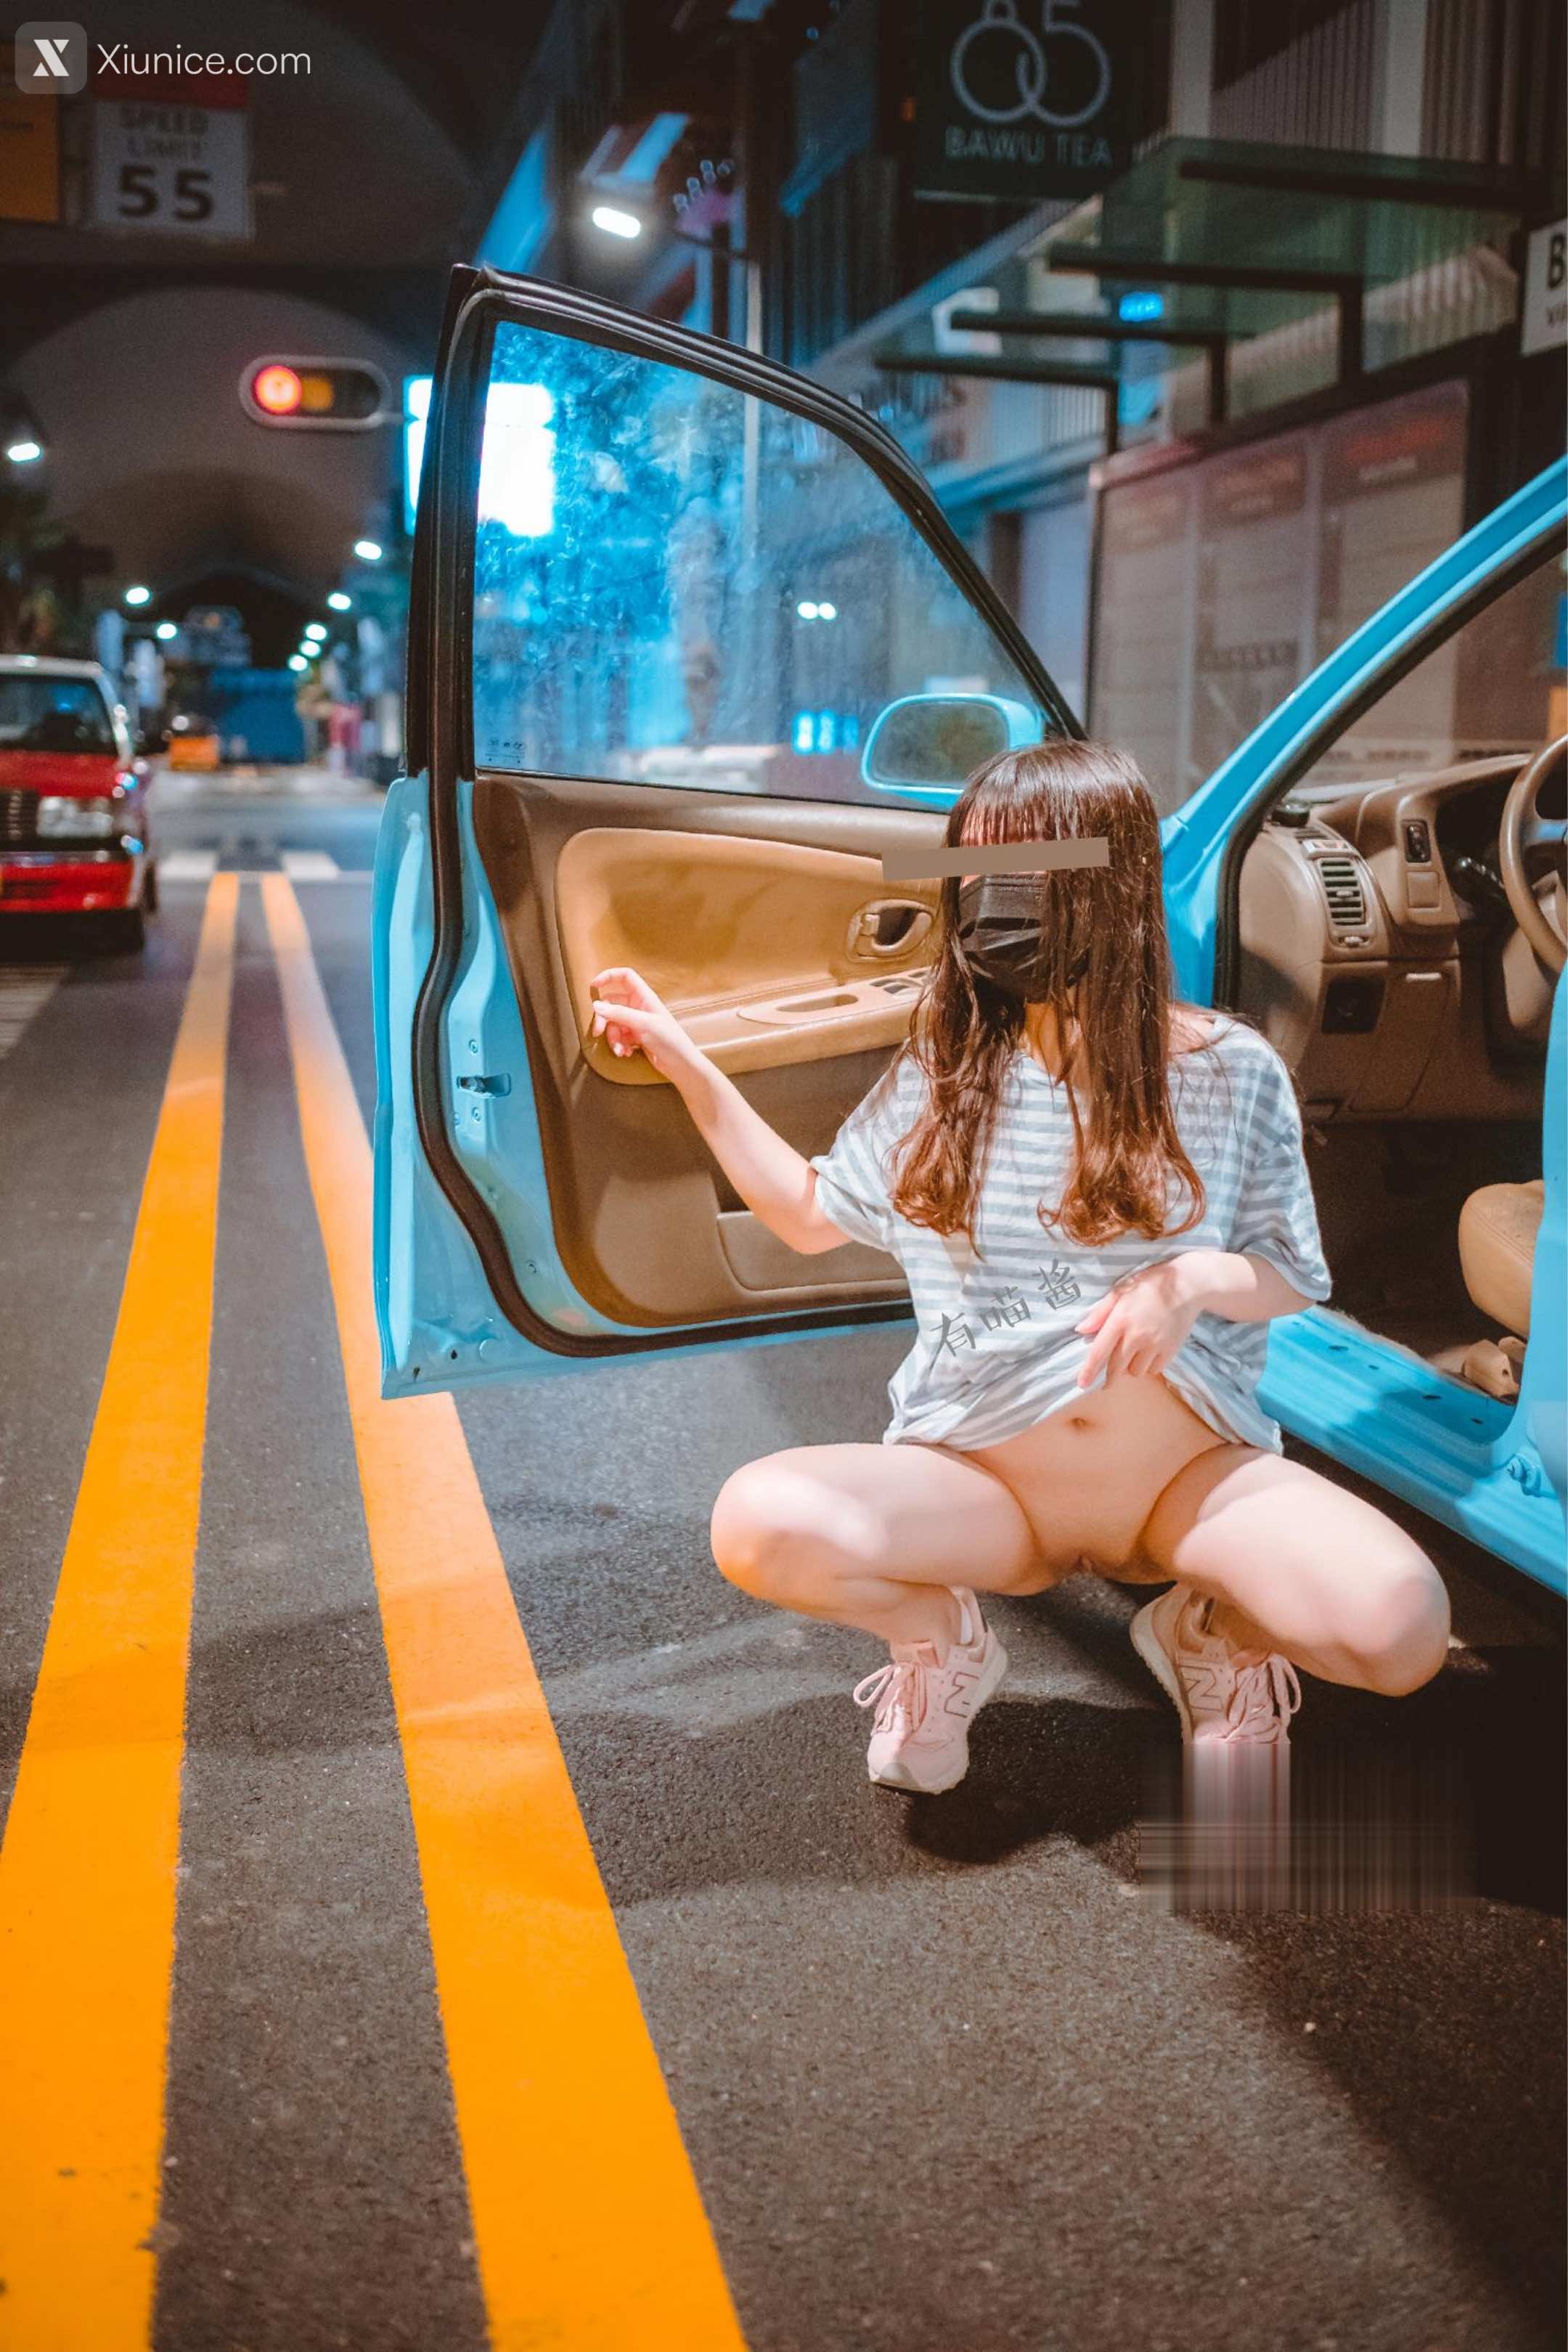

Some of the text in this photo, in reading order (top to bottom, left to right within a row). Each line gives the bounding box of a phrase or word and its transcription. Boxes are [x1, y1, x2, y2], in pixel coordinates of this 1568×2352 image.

[119, 105, 209, 136] SPEED
[945, 126, 1112, 167] BAWU TEA
[118, 164, 215, 222] 55
